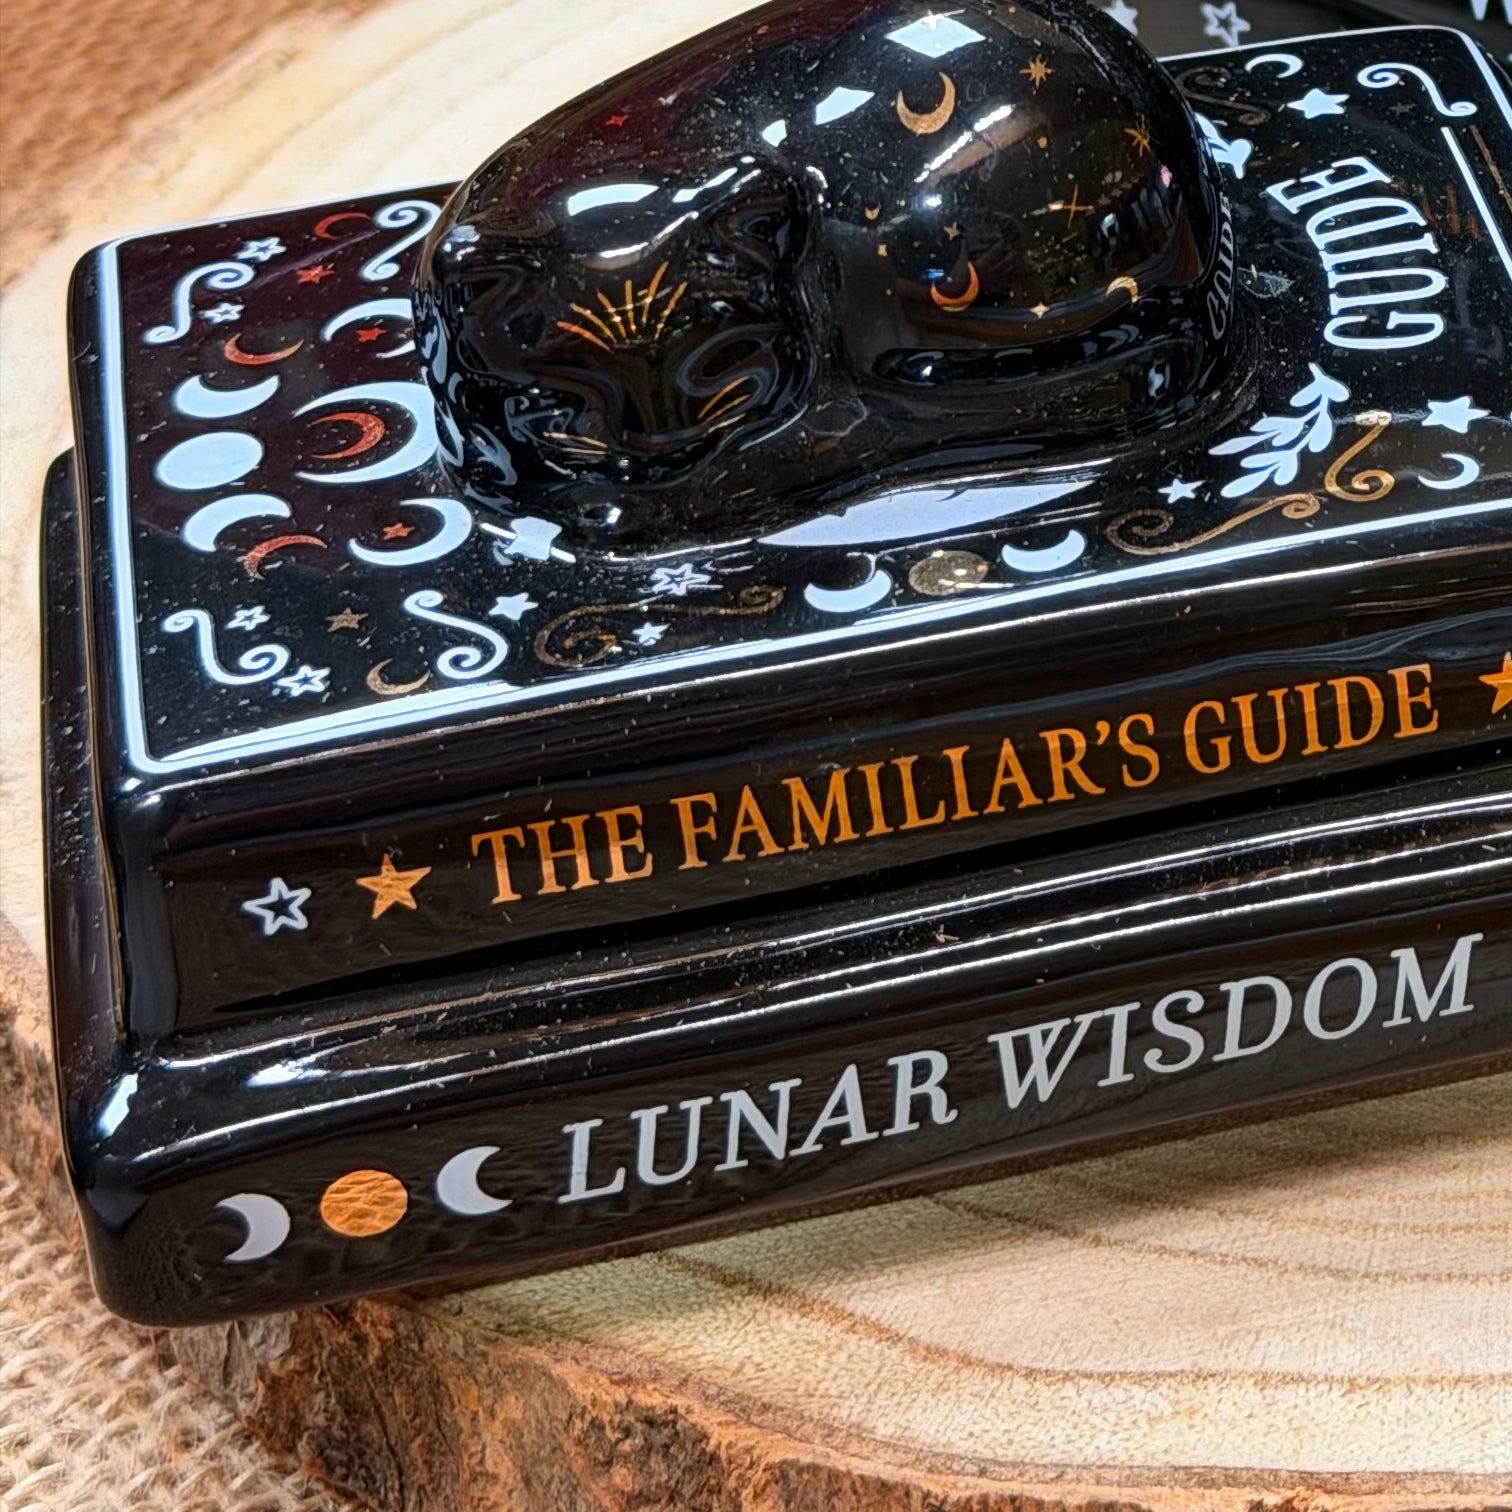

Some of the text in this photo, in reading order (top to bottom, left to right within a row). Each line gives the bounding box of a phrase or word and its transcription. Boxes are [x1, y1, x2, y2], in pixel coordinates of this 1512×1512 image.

[1265, 155, 1448, 350] GUIDE
[471, 662, 1441, 906] THE FAMILIAR’S GUIDE
[557, 931, 1485, 1205] LUNAR WISDOM
